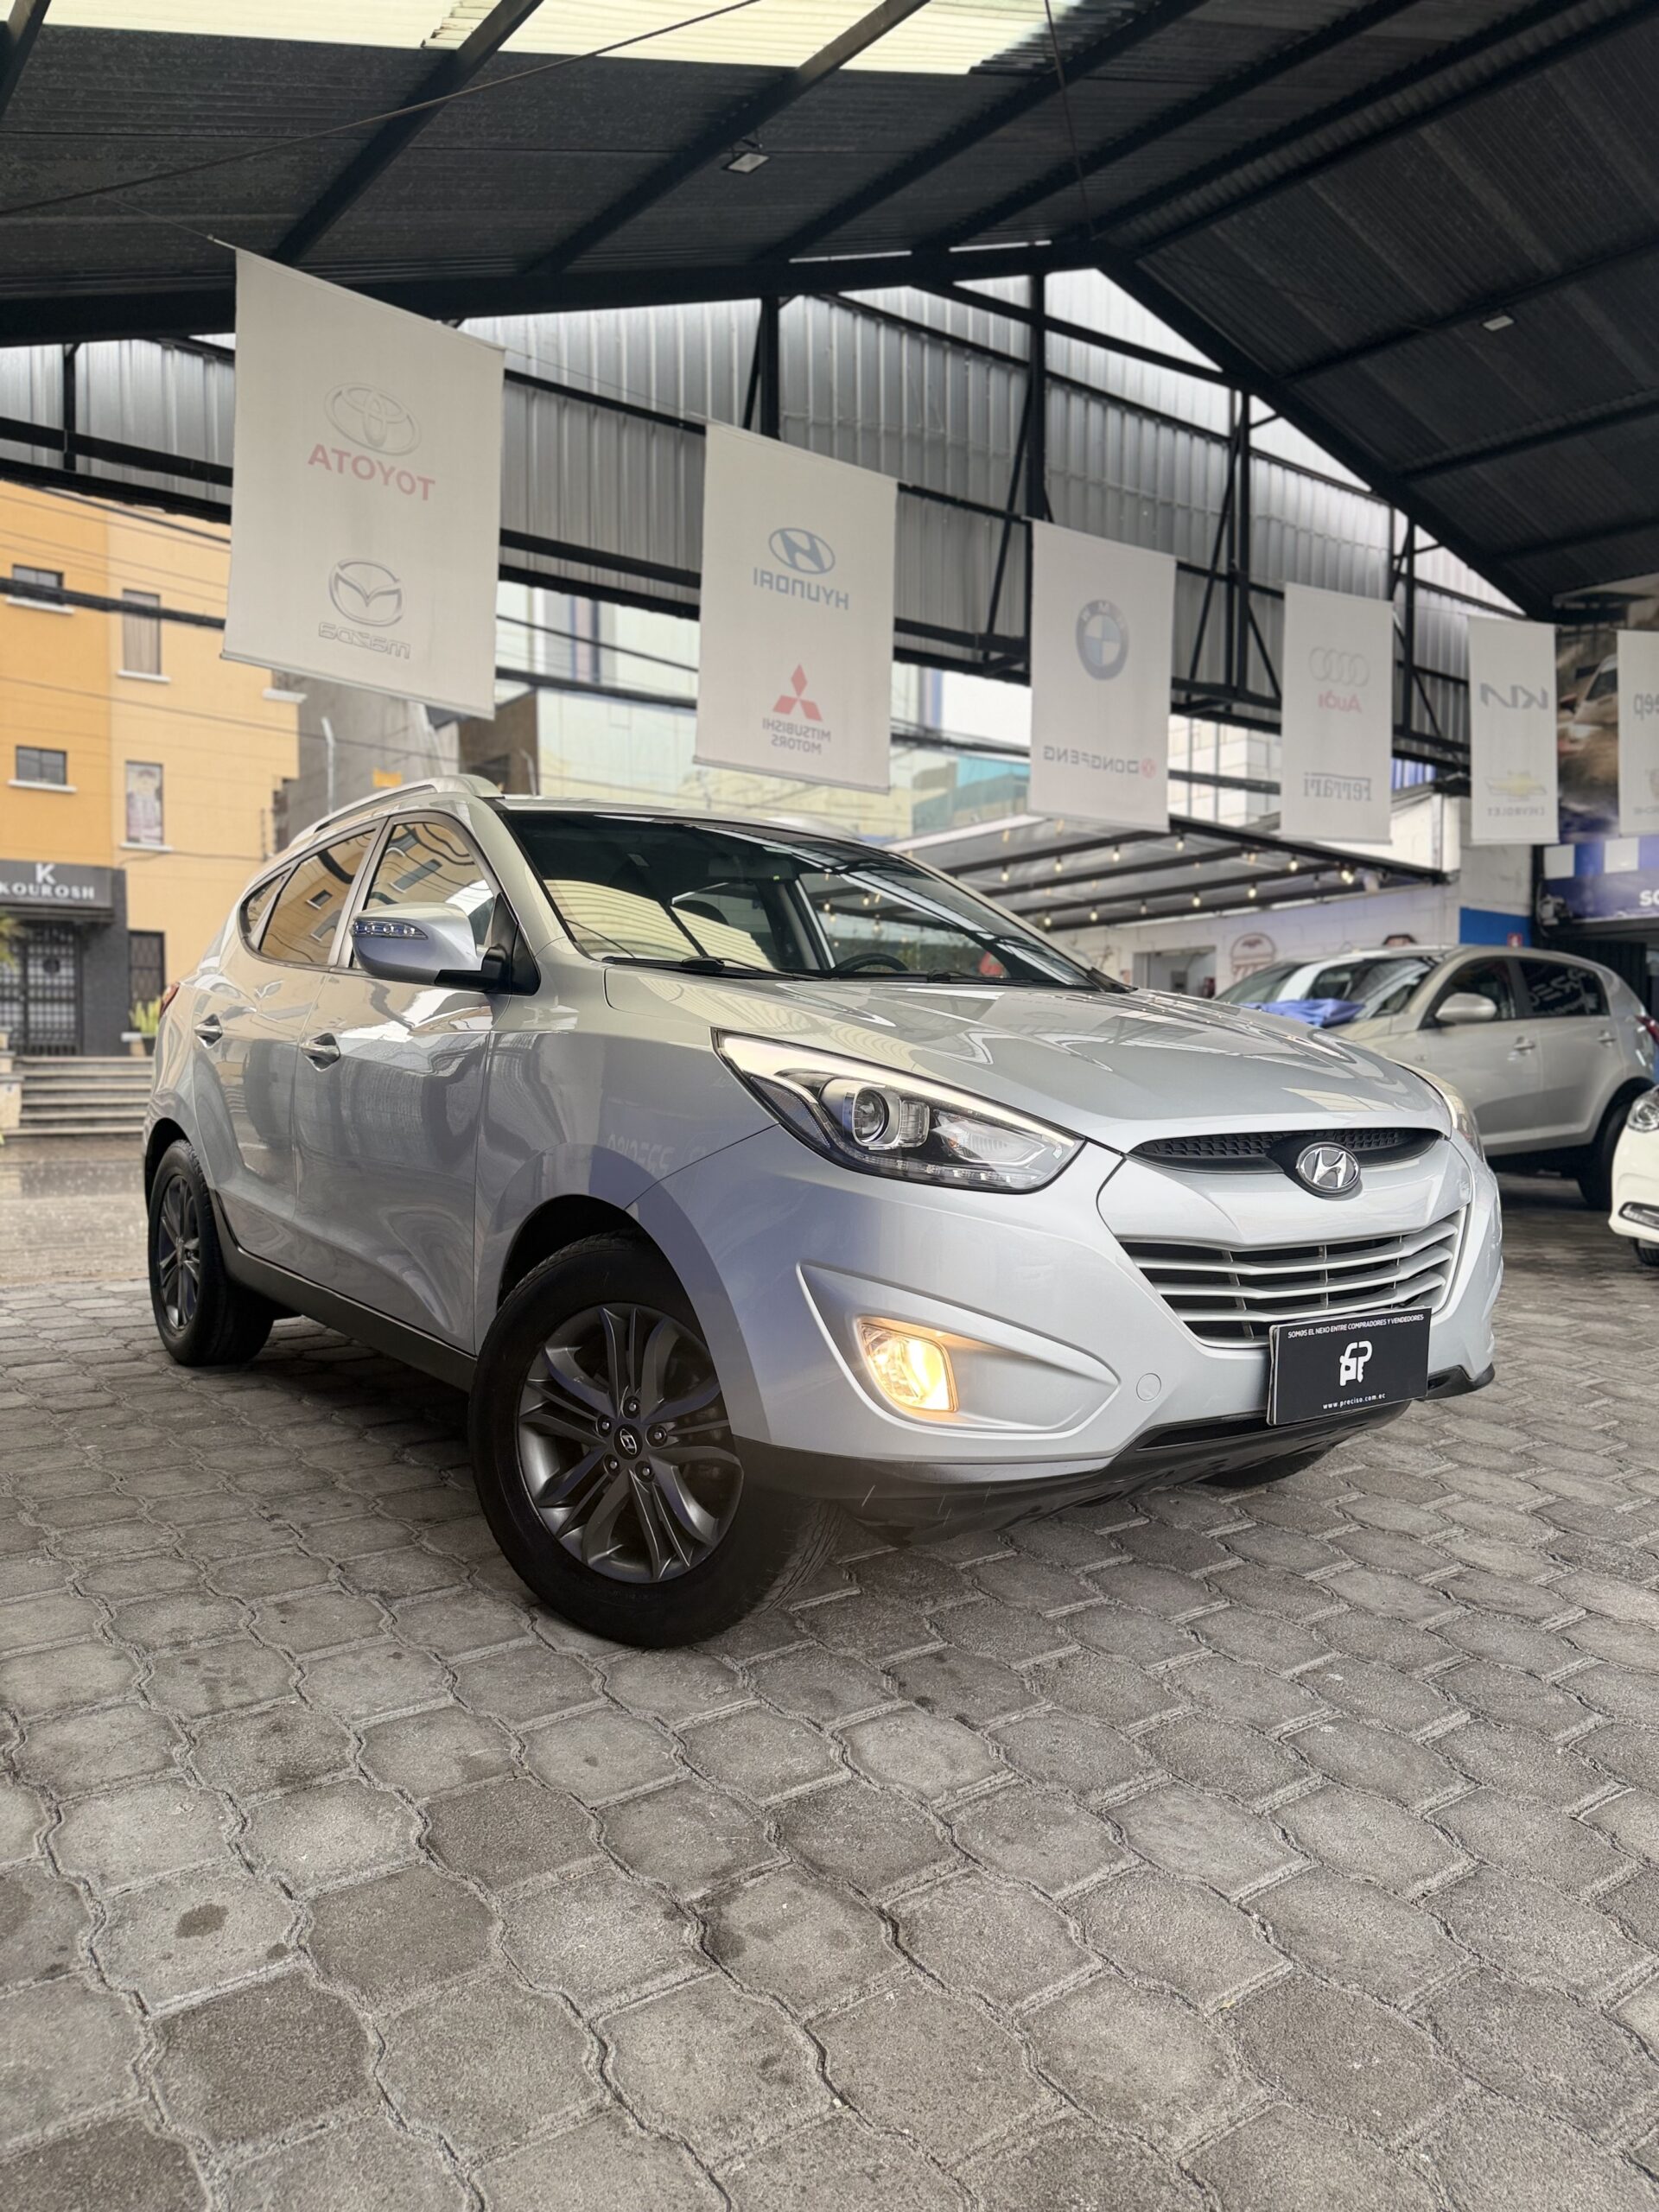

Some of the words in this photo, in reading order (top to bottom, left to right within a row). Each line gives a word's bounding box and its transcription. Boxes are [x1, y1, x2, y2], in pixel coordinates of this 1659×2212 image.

[35, 862, 56, 885] K
[1287, 1329, 1308, 1338] SOMOS
[1308, 1327, 1315, 1336] EL
[1315, 1326, 1331, 1335] NEXO
[1331, 1324, 1347, 1332] ENTRE
[1348, 1319, 1387, 1330] COMPRADORES
[1391, 1313, 1424, 1324] VENDEDORES
[1322, 1393, 1386, 1409] www.preciso.com.ec
